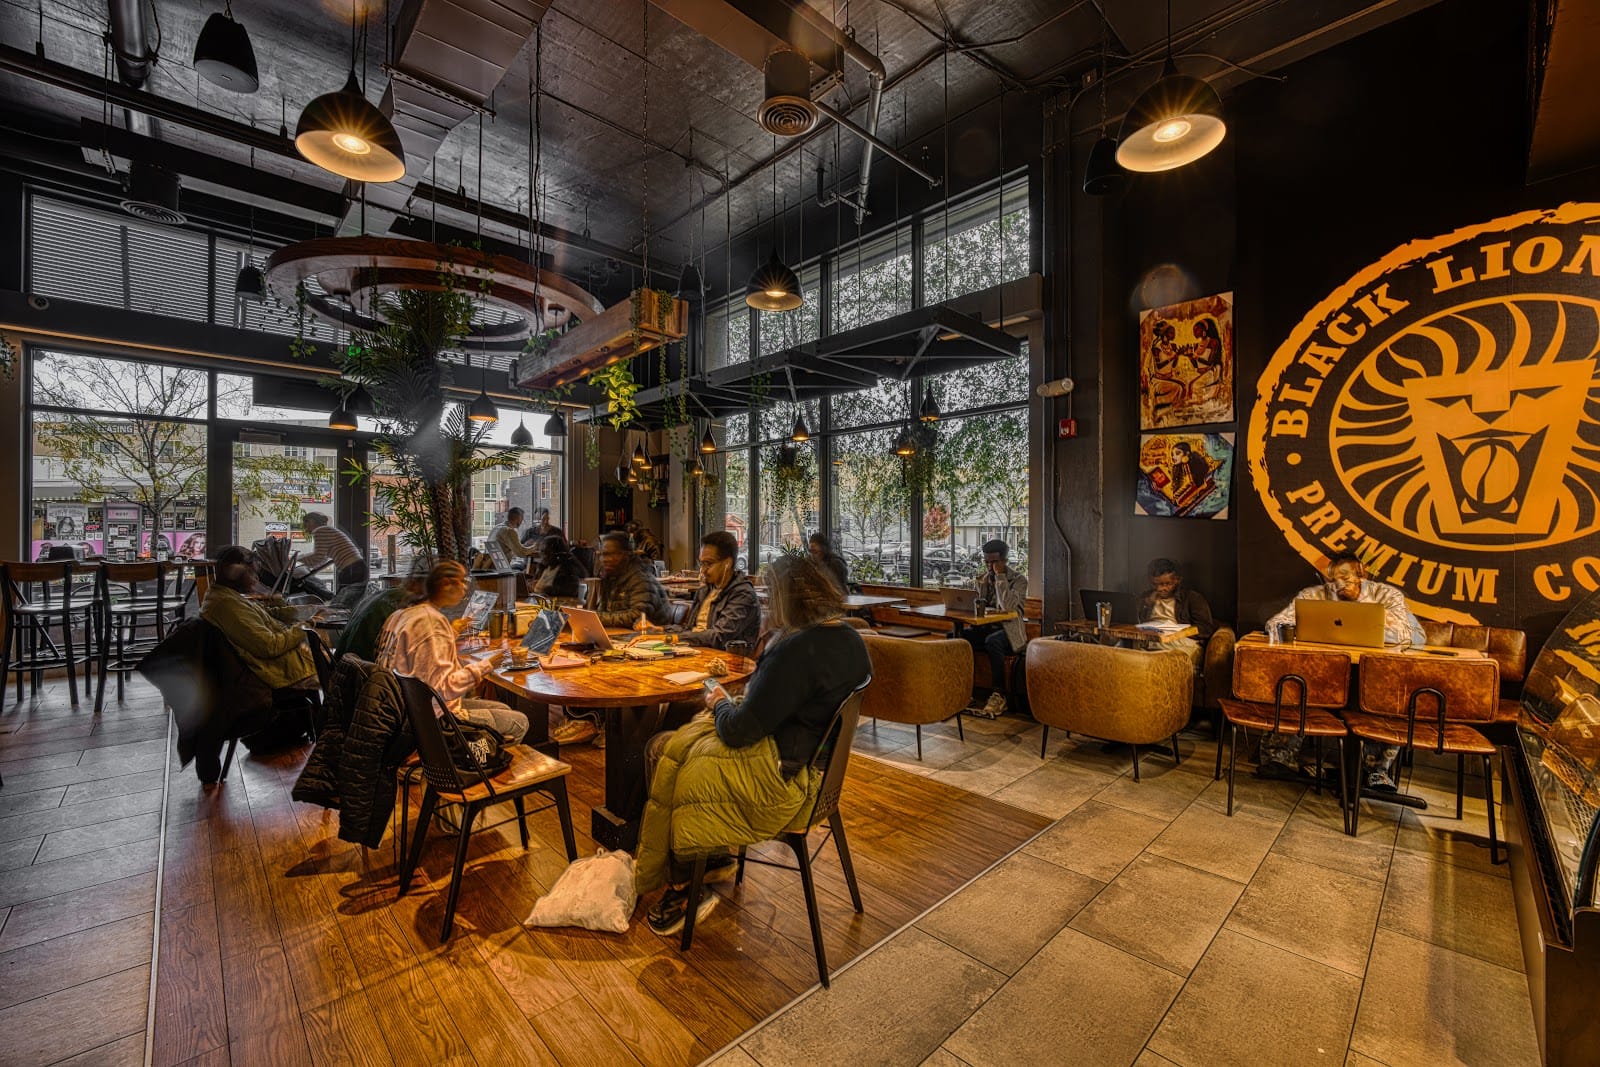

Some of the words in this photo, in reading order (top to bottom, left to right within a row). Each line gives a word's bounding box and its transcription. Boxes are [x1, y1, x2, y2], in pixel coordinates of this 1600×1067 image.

[1271, 283, 1410, 438] BLACK
[97, 424, 133, 433] LEASING
[1286, 480, 1499, 604] PREMIUM
